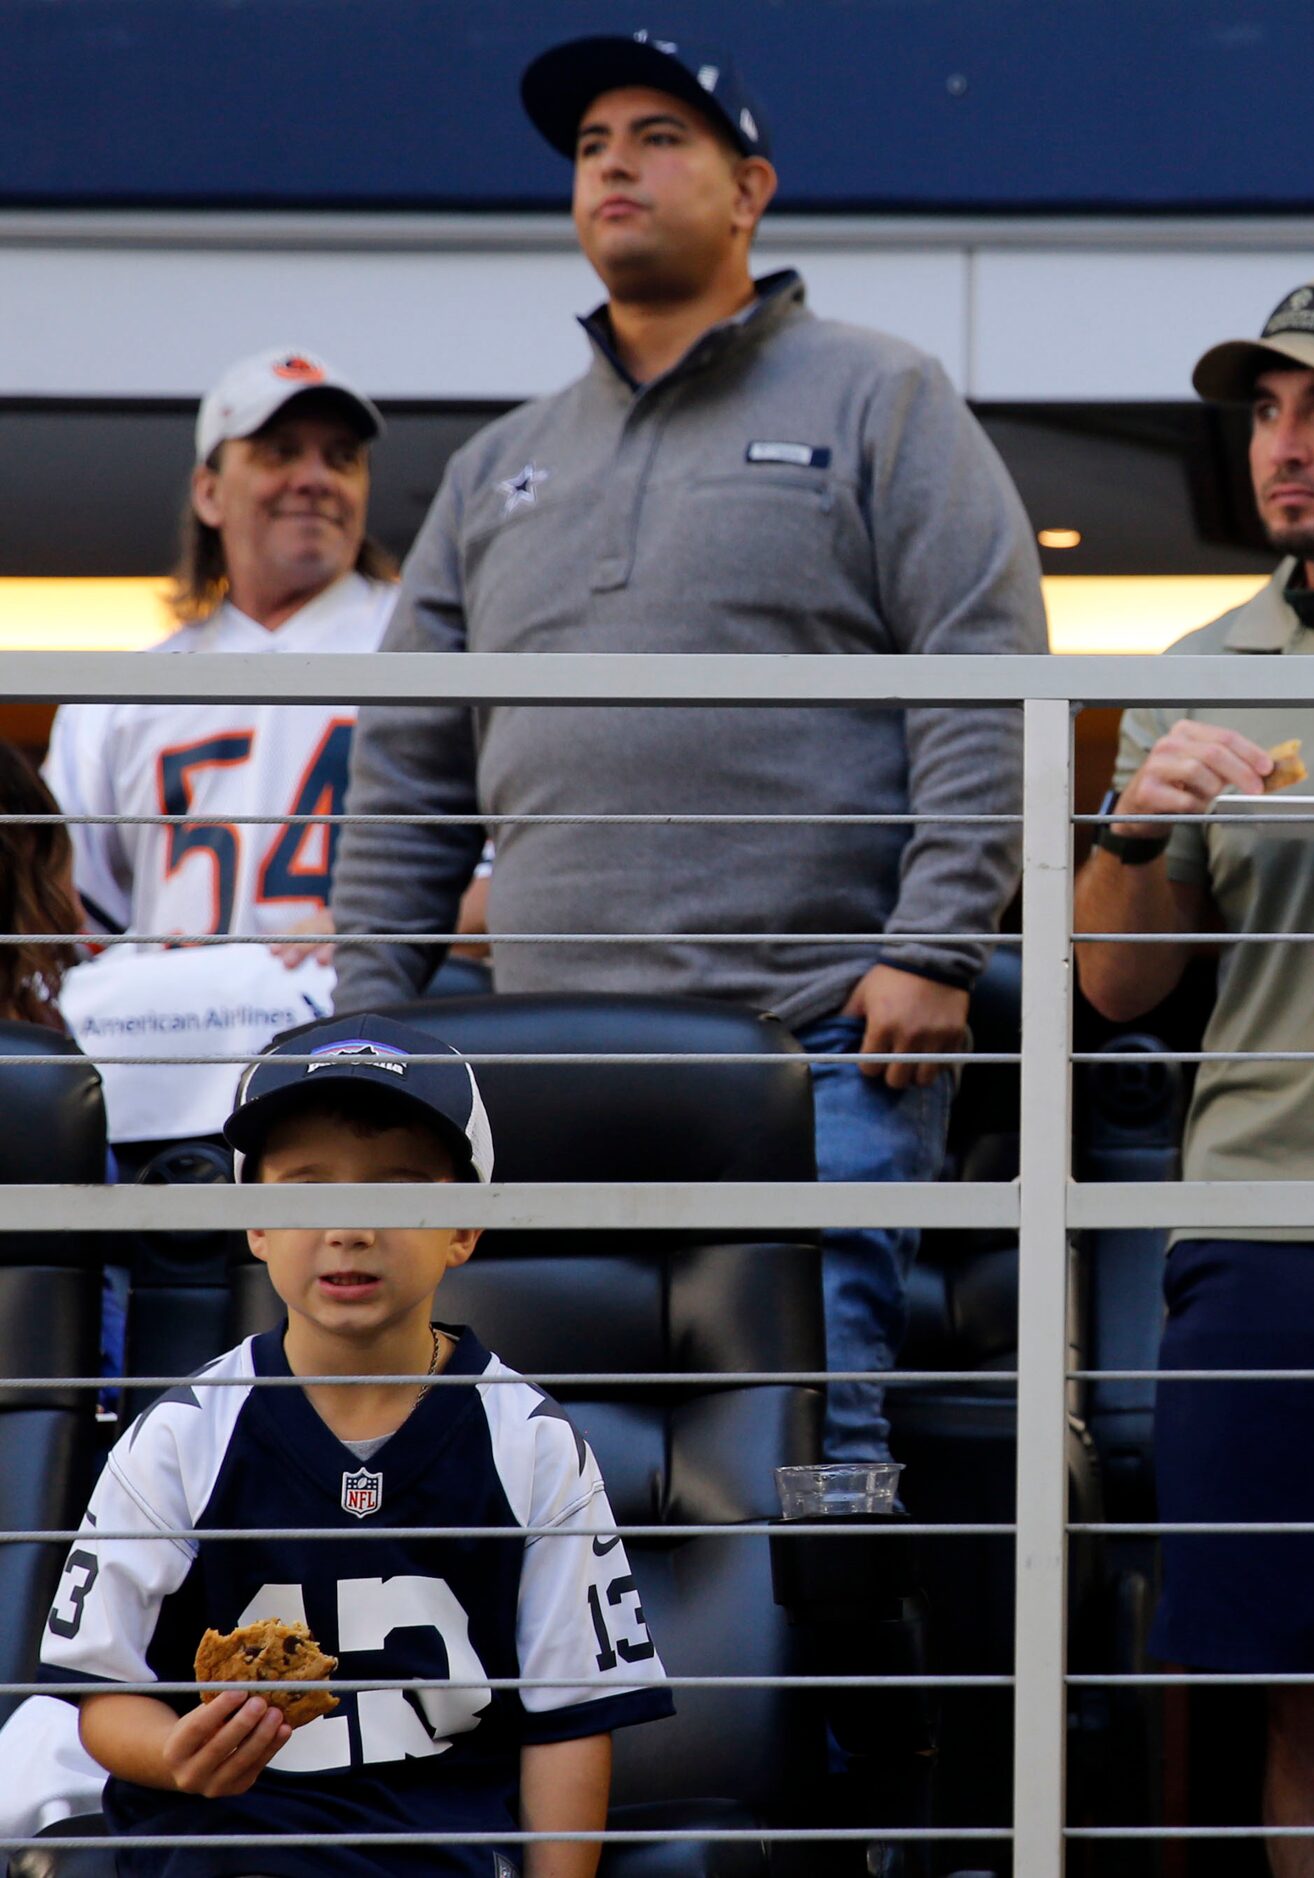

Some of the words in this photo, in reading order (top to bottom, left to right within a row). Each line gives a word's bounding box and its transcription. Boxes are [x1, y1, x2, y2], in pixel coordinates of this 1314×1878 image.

[155, 715, 358, 950] 54
[84, 1010, 201, 1038] American
[205, 1005, 297, 1030] Airlines
[348, 1491, 375, 1510] NFL
[587, 1574, 655, 1672] 13
